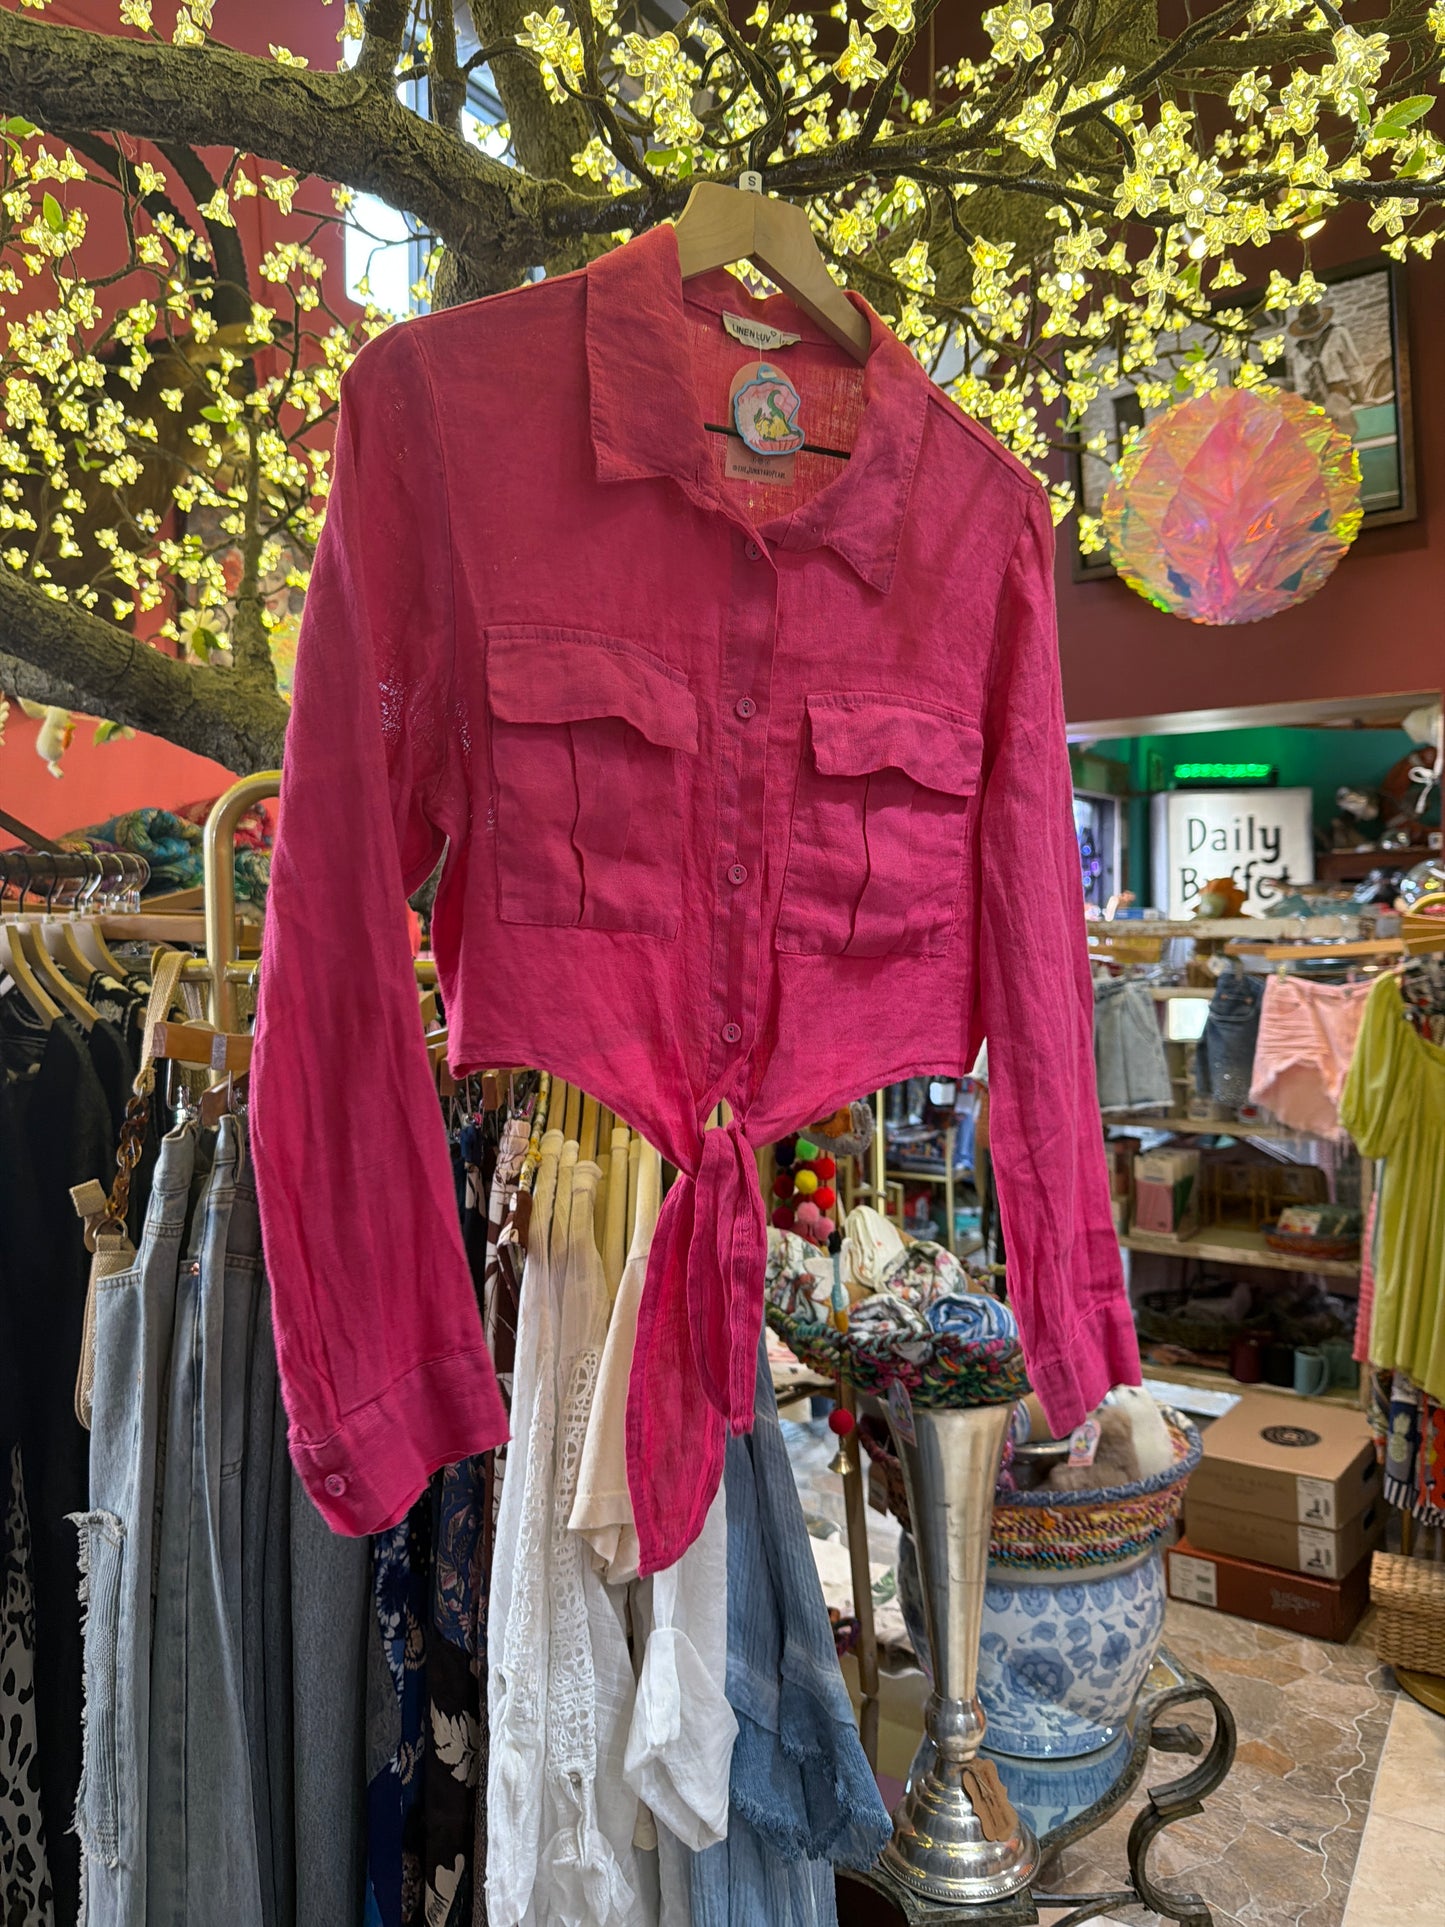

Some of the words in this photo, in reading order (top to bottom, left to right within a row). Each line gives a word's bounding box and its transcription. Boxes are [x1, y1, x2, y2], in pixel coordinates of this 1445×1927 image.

[748, 175, 757, 187] S
[732, 323, 755, 339] LINEN
[1187, 815, 1281, 864] Daily
